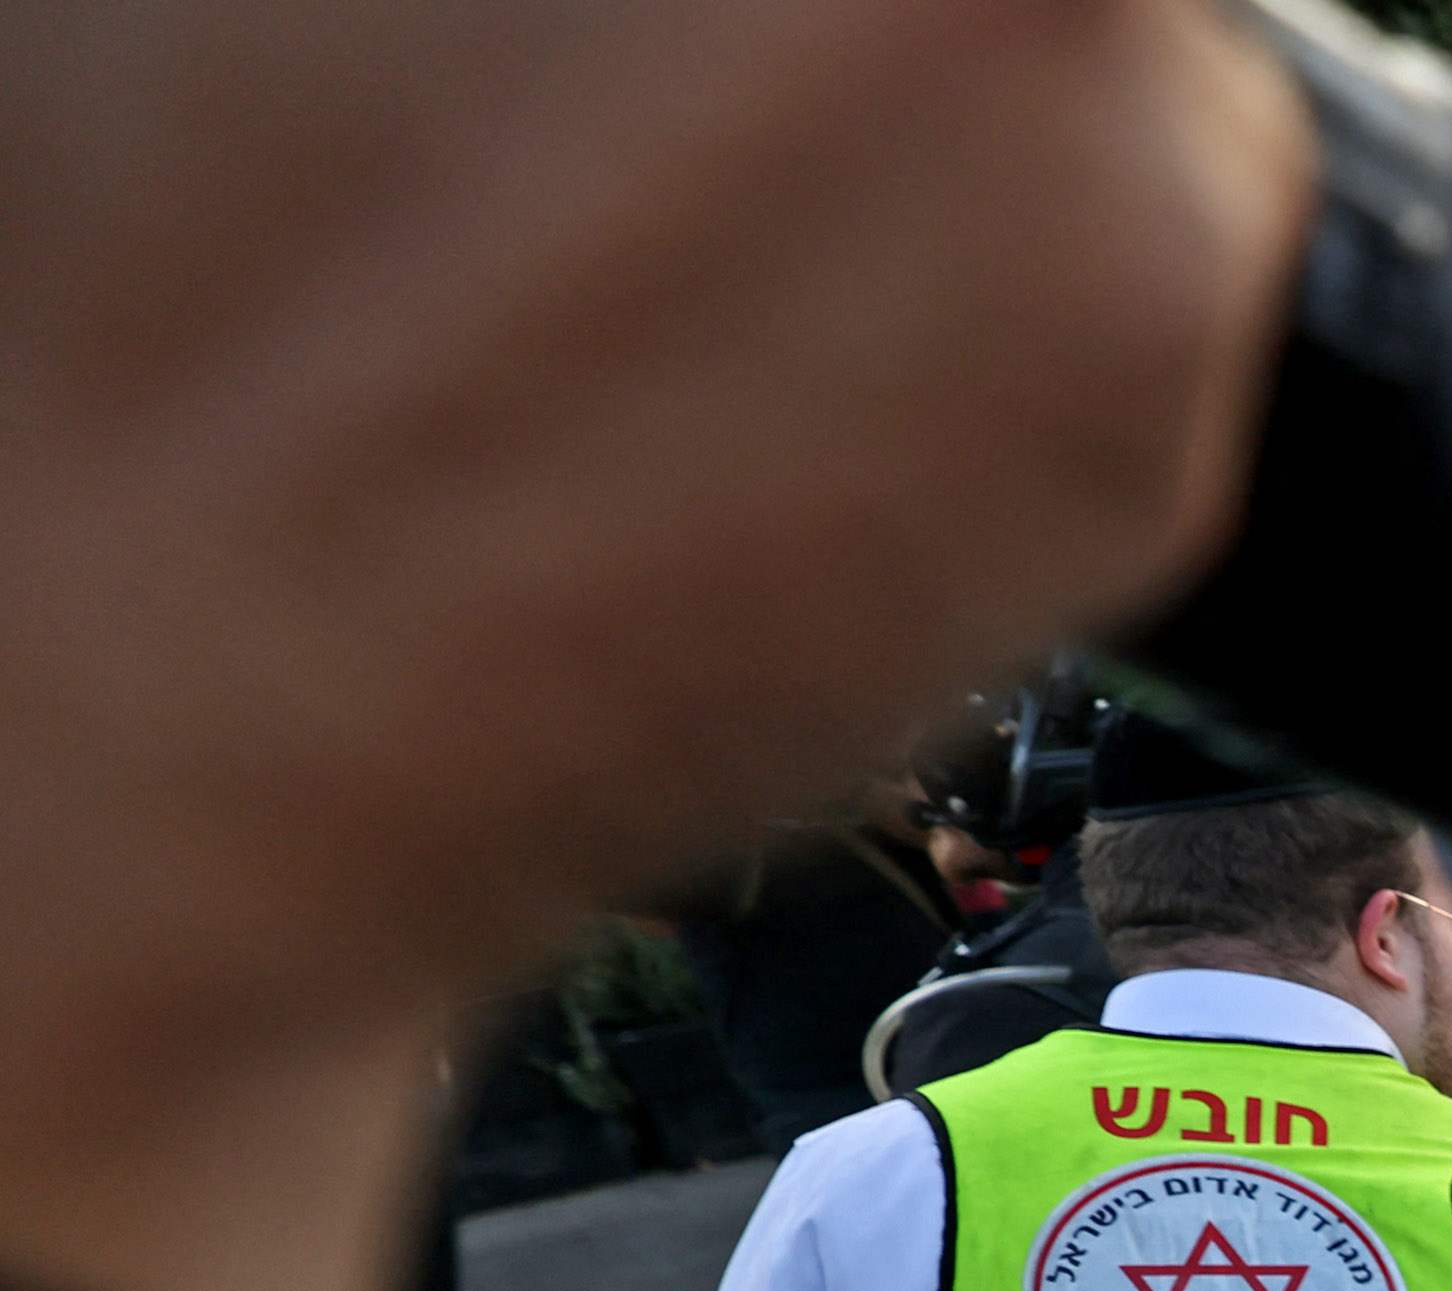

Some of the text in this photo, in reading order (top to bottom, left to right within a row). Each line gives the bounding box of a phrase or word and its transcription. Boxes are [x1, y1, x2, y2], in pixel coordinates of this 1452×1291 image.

[1092, 1086, 1329, 1147] חובש
[1045, 1175, 1376, 1287] מגן דוד אדום בישראל
